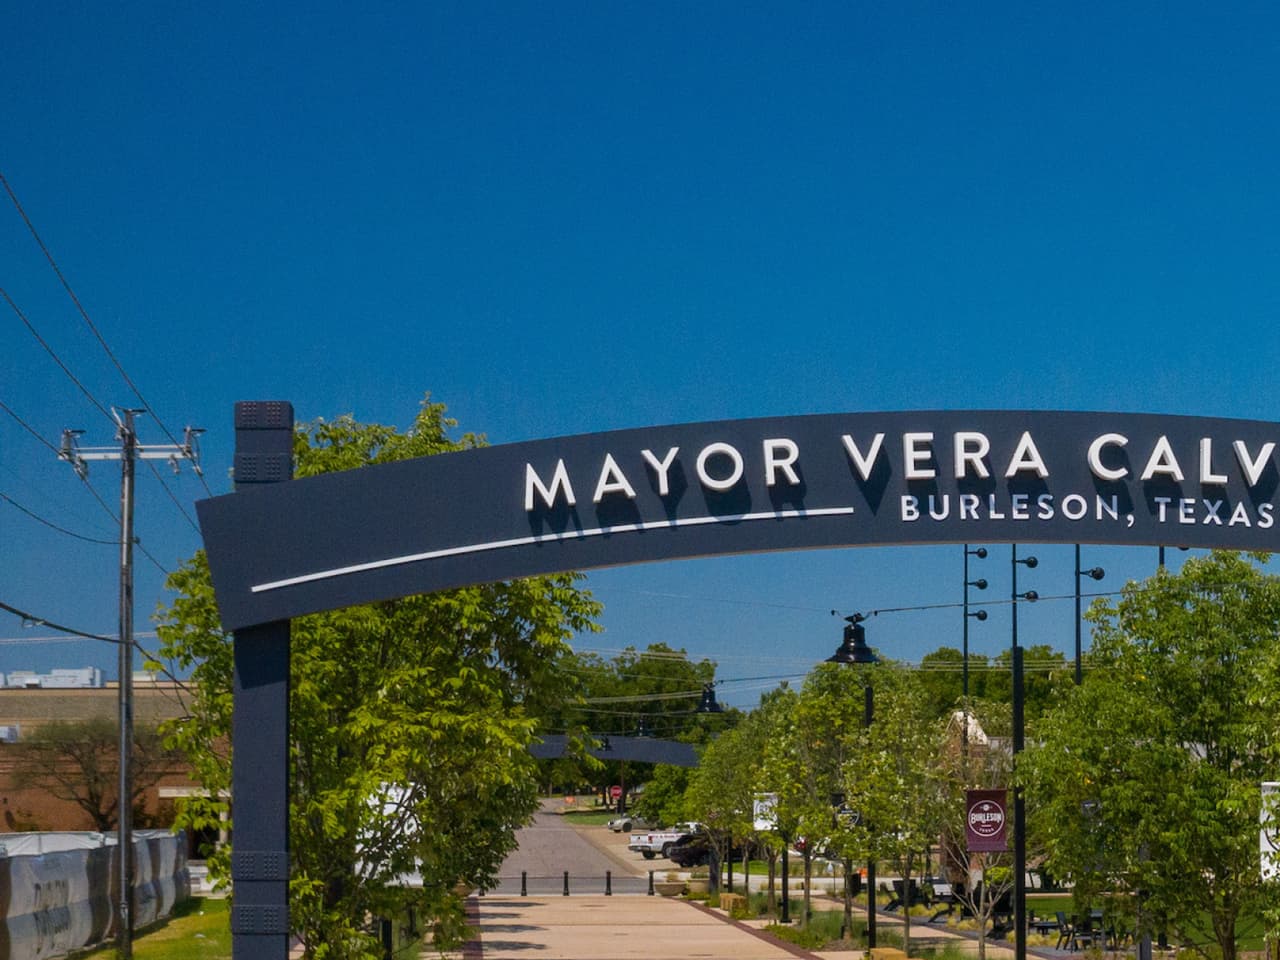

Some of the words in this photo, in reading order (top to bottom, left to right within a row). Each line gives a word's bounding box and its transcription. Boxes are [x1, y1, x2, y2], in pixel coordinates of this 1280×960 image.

[525, 438, 800, 511] MAYOR
[841, 431, 1049, 481] VERA
[901, 494, 1135, 528] BURLESON,
[1154, 497, 1275, 529] TEXAS
